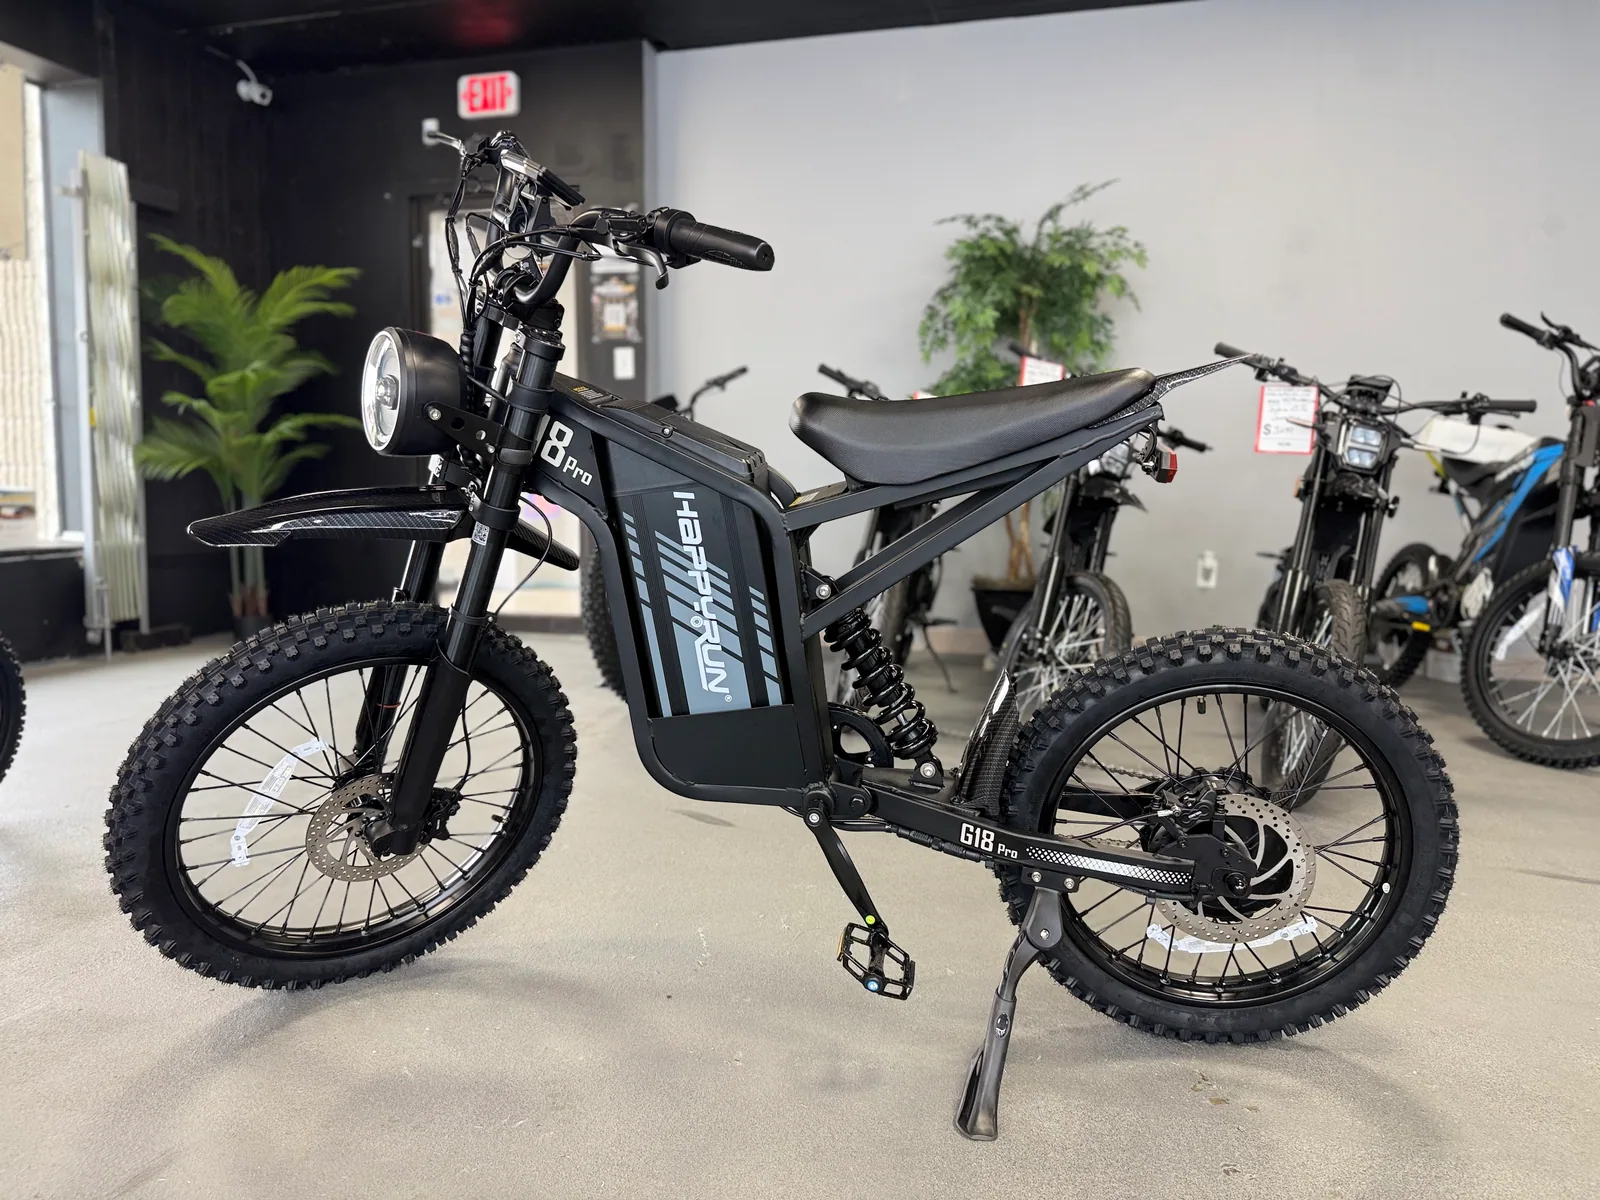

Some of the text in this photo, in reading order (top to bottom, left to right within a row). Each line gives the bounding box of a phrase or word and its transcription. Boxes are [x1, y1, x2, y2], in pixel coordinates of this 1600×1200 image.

[468, 73, 507, 112] EXIT
[562, 455, 593, 486] Pro
[960, 822, 1018, 859] G18 Pro
